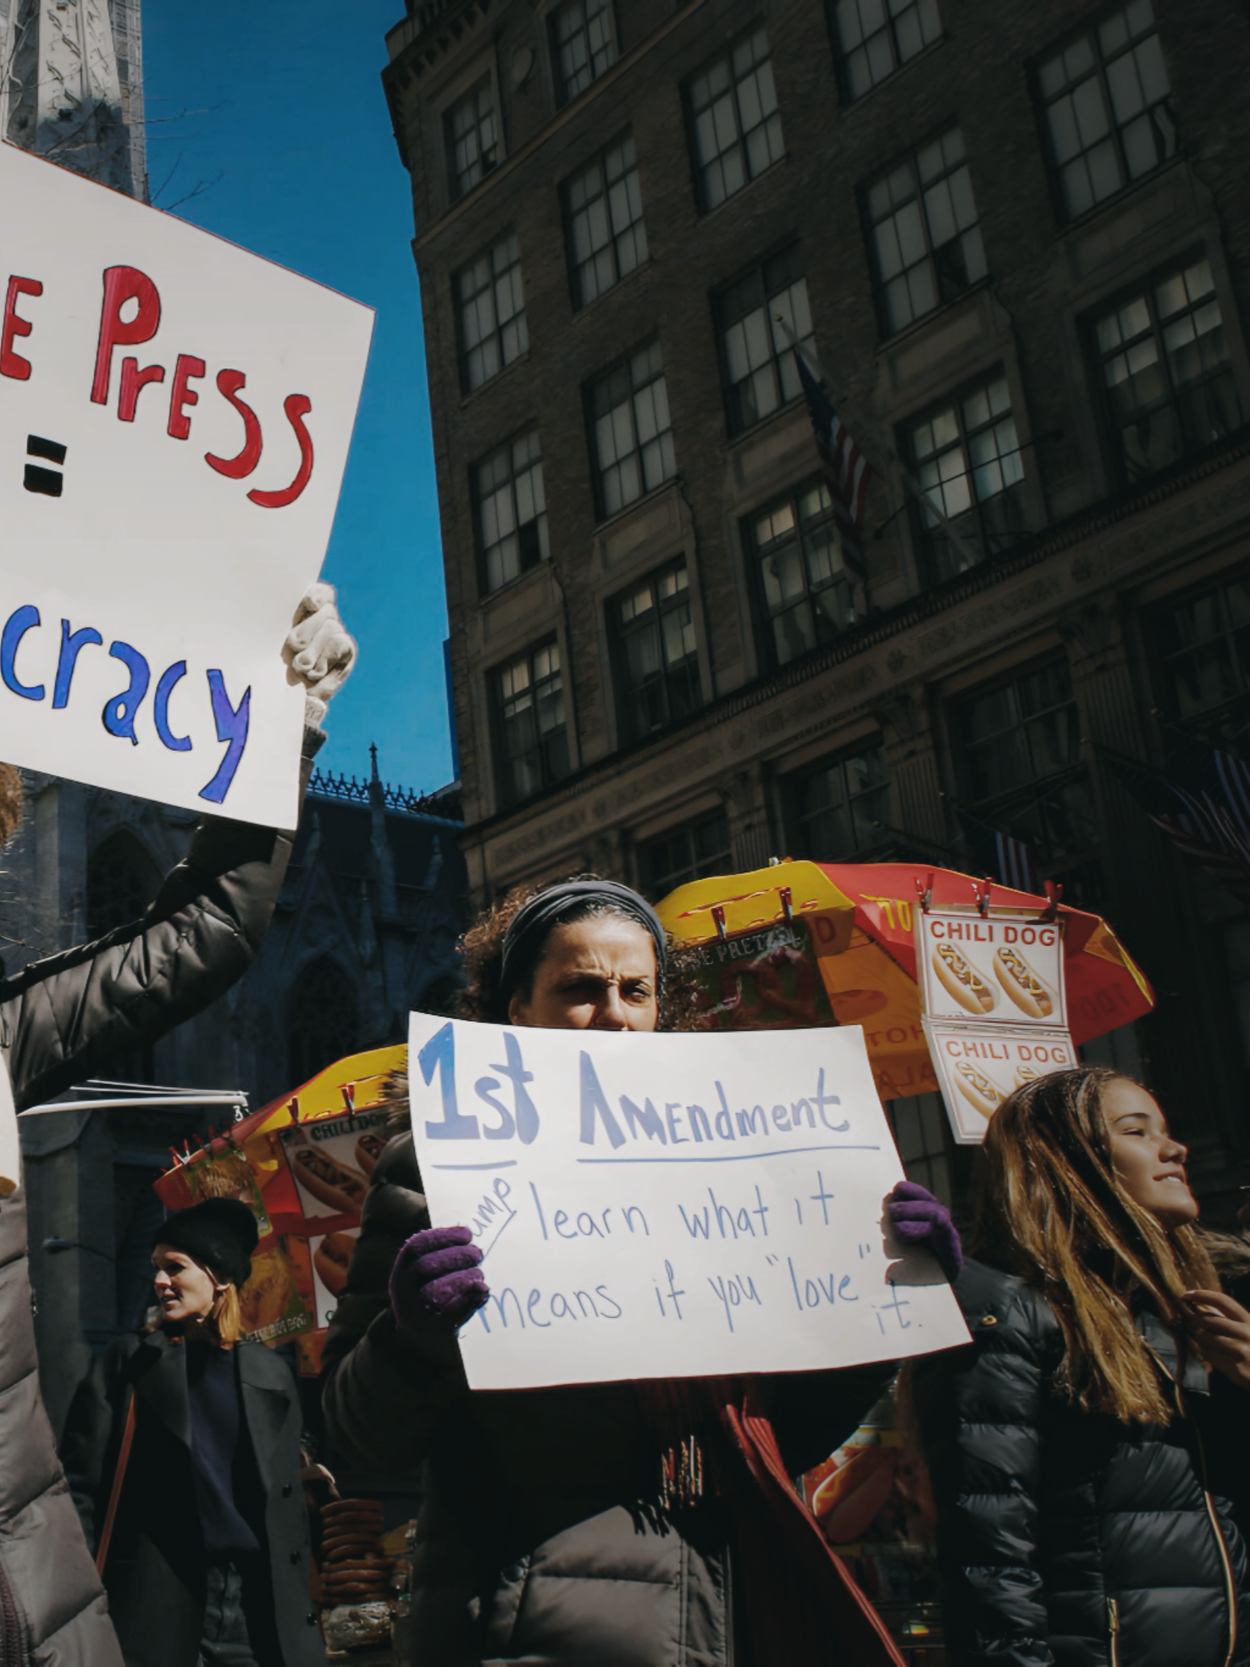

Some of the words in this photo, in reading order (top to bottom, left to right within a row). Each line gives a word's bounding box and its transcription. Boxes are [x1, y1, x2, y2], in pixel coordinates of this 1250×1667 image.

[930, 920, 994, 943] CHILI
[1003, 926, 1056, 947] DOG
[945, 1040, 1010, 1060] CHILI
[1017, 1044, 1067, 1064] DOG
[417, 1020, 541, 1145] 1st
[358, 1113, 384, 1131] DO
[528, 1181, 650, 1241] learn
[677, 1184, 770, 1240] what
[794, 1170, 835, 1226] it
[477, 1284, 623, 1334] means
[653, 1259, 685, 1321] if
[706, 1271, 761, 1333] you
